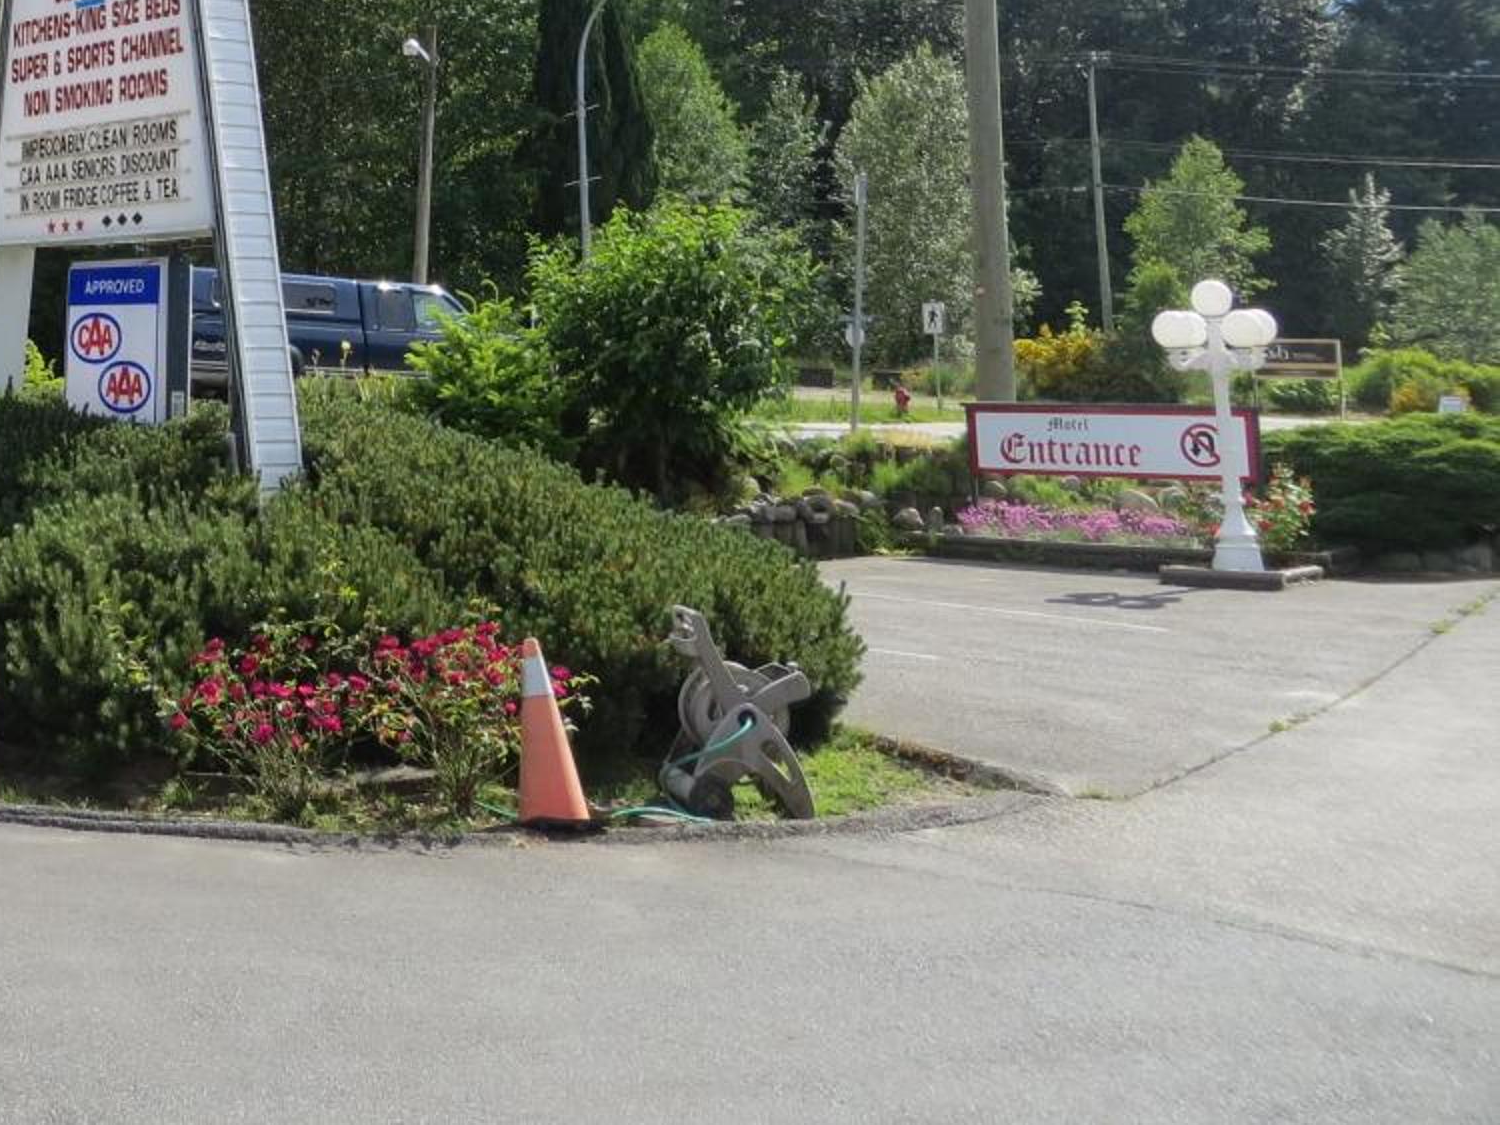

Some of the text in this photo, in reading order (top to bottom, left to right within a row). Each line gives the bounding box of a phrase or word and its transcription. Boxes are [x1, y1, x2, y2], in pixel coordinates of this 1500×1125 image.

[11, 55, 49, 83] SUPER
[67, 41, 115, 73] SPORTS
[121, 27, 184, 63] CHANNEL
[24, 69, 168, 117] NON SMOKING ROOMS
[88, 127, 127, 150] CLEAN
[133, 120, 177, 145] ROOMS
[46, 160, 68, 182] AAA
[71, 155, 116, 180] SENIORS
[121, 148, 178, 177] DISCOUNT
[63, 186, 98, 208] FRIDGE
[101, 181, 139, 205] COFFEE
[157, 177, 179, 199] TEA
[85, 278, 145, 295] APPROVED
[78, 316, 113, 356] CAA
[106, 366, 142, 405] AAA
[1047, 416, 1088, 432] Motel
[1000, 432, 1141, 467] Entrance
